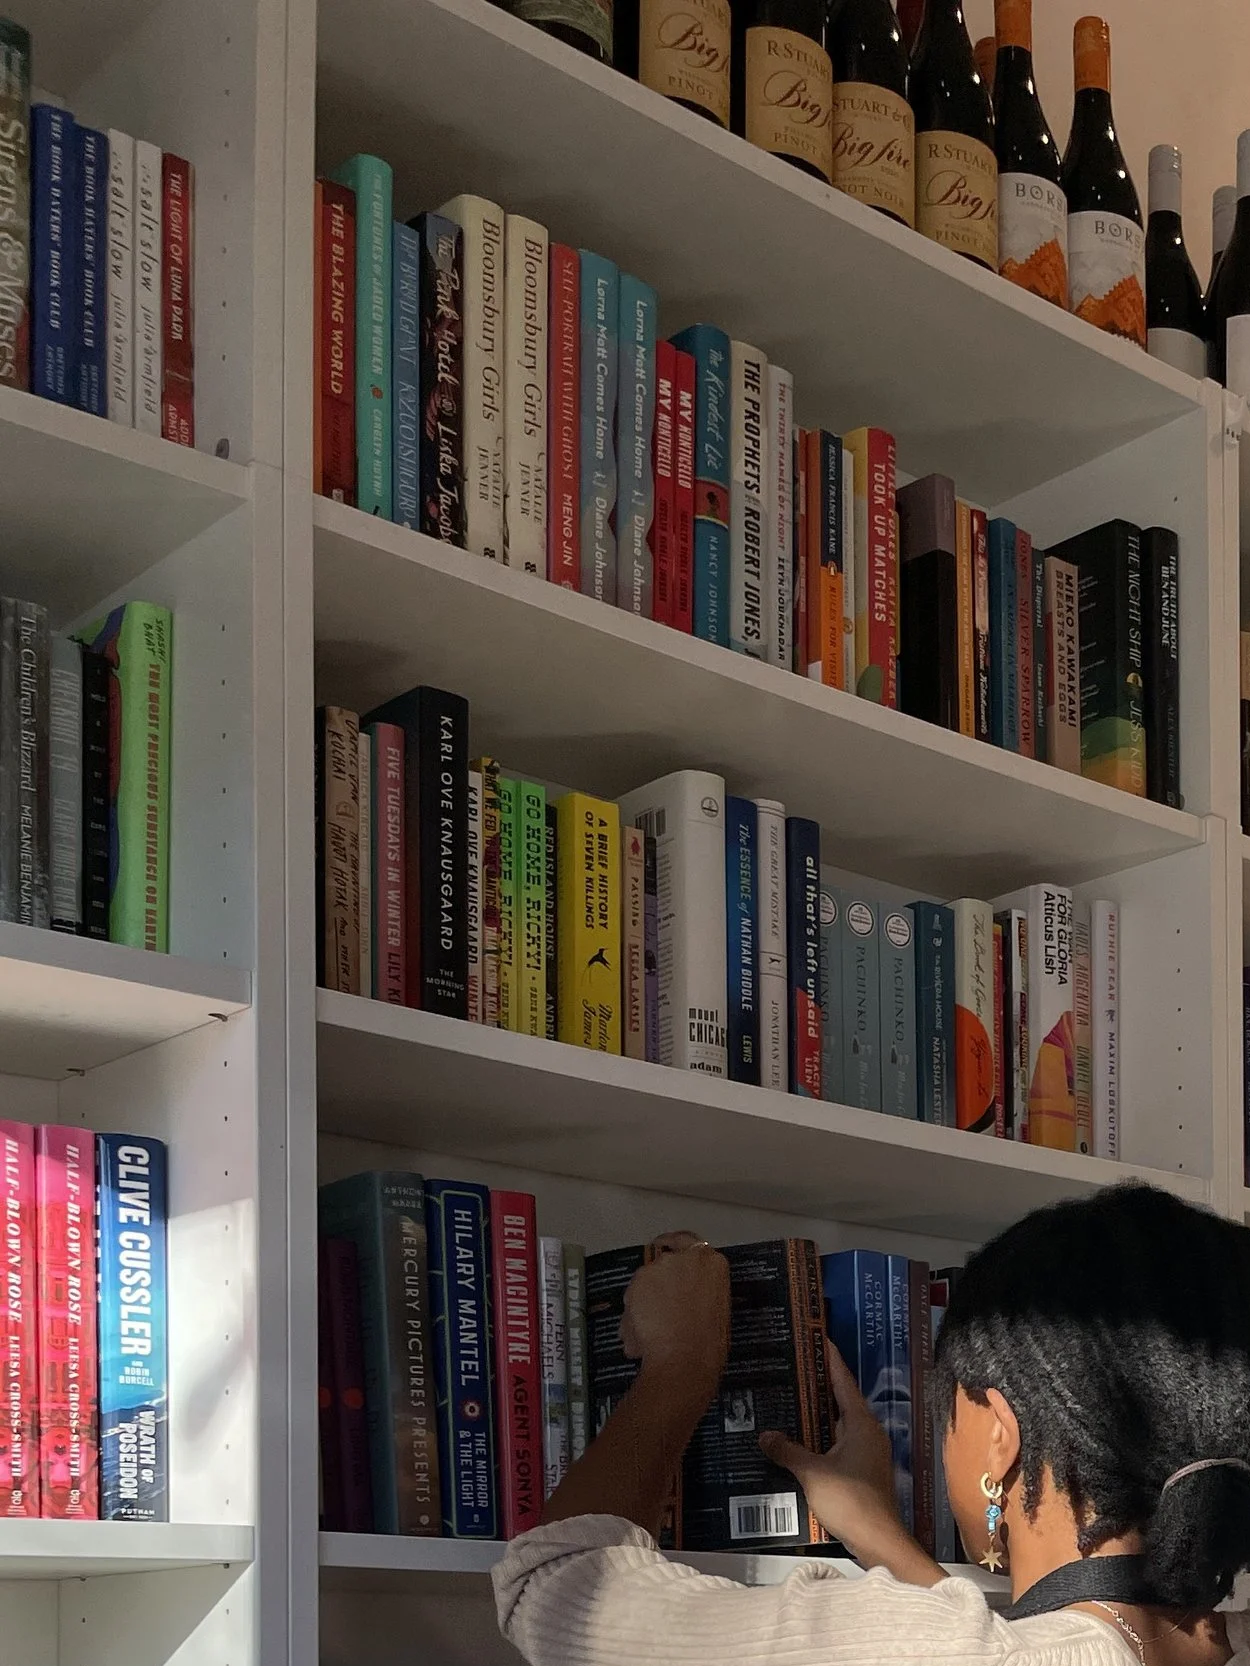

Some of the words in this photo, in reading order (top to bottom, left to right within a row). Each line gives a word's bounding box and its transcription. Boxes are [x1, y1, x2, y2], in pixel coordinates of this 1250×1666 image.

[333, 204, 345, 235] THE
[332, 239, 345, 326] BLAZING
[480, 218, 500, 361] Bloomsbury
[596, 279, 607, 321] Lorna
[331, 330, 345, 394] WORLD
[596, 324, 609, 360] Mott
[481, 365, 501, 426] Girls
[596, 364, 608, 413] Comes
[659, 379, 672, 410] MY
[743, 360, 760, 398] THE
[595, 415, 607, 463] Home
[657, 409, 672, 477] MONTICELLO
[743, 405, 760, 494] PROPHETS
[873, 463, 886, 509] TOOK
[562, 494, 574, 534] MENG
[874, 515, 886, 539] UP
[562, 537, 574, 567] JIN
[743, 507, 760, 574] ROBERT
[743, 577, 760, 640] JONES,
[874, 544, 887, 623] MATCHES
[1055, 569, 1064, 641] BREASTS
[1064, 573, 1075, 629] MIEKO
[19, 616, 36, 646] The
[1056, 643, 1066, 674] AND
[1066, 634, 1077, 727] KAWAKAMI
[20, 648, 37, 722] Children's
[1058, 680, 1067, 724] EGGS
[20, 723, 37, 792] Blizzard
[440, 716, 452, 763] KARL
[441, 772, 453, 810] OVE
[526, 794, 541, 822] GO
[584, 811, 593, 829] OF
[598, 819, 607, 829] A
[584, 833, 594, 879] SEVEN
[597, 832, 608, 867] BRIEF
[740, 848, 751, 901] ESSENCE
[806, 856, 816, 881] all
[440, 817, 453, 951] KNAUSGAARD
[584, 880, 594, 931] KILLINGS
[598, 869, 609, 931] HISTORY
[526, 898, 541, 970] RICKY!
[805, 885, 818, 935] that's
[1043, 891, 1055, 943] Atticus
[1056, 894, 1067, 926] FOR
[741, 917, 752, 968] NATHAN
[806, 940, 818, 973] left
[1043, 945, 1055, 975] Lish
[1057, 927, 1068, 986] GLORIA
[741, 970, 752, 1012] BIDDLE
[806, 978, 818, 1039] unsaid
[65, 1143, 82, 1270] HALF-BLOWN
[118, 1146, 150, 1226] CLIVE
[454, 1209, 475, 1290] HILARY
[503, 1213, 526, 1257] BEN
[67, 1273, 82, 1325] ROSE
[119, 1231, 151, 1356] CUSSLER
[504, 1258, 531, 1365] MACINTYRE
[69, 1338, 79, 1378] LEESA
[457, 1298, 480, 1387] MANTEL
[119, 1375, 154, 1386] BURCELL
[124, 1367, 150, 1375] ROBIN
[69, 1383, 80, 1478] CROSS-SMITH
[512, 1373, 528, 1440] AGENT
[139, 1410, 156, 1465] WRATH
[458, 1430, 471, 1441] &
[459, 1442, 472, 1466] THE
[474, 1431, 486, 1455] THE
[119, 1423, 138, 1501] POSEIDON
[143, 1467, 153, 1484] OF
[475, 1458, 490, 1508] MIRROR
[516, 1447, 531, 1518] SONYA
[460, 1471, 475, 1508] LIGHT
